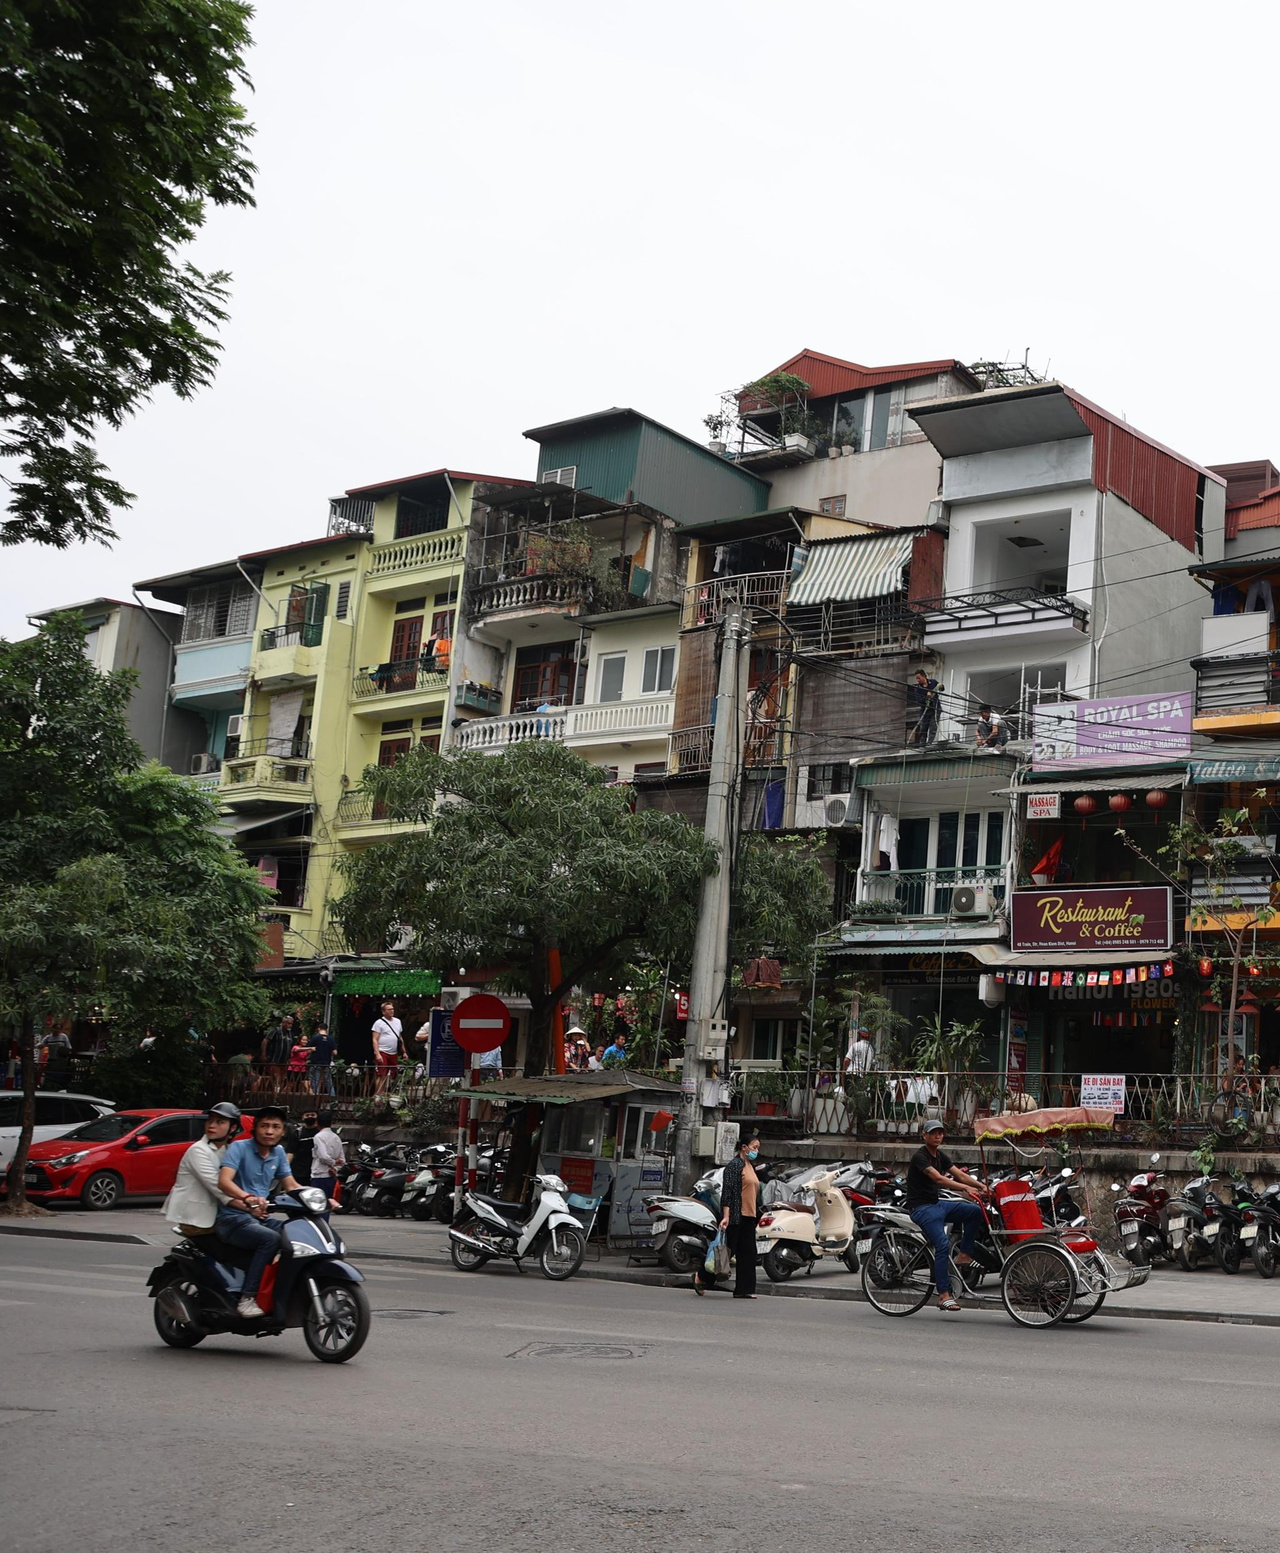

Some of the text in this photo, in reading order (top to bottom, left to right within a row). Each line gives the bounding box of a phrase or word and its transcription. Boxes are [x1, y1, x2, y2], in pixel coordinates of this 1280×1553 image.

[1084, 700, 1184, 725] ROYAL SPA
[1079, 746, 1096, 755] BODY
[1155, 737, 1187, 748] SHAMPOO
[1029, 796, 1057, 808] MASSAGE
[1032, 809, 1051, 817] SPA
[1037, 896, 1132, 934] Restaurant
[1079, 921, 1142, 938] & Coffee
[1131, 998, 1178, 1009] FLOWER
[1083, 1077, 1091, 1086] XE
[1112, 1077, 1124, 1087] BAY
